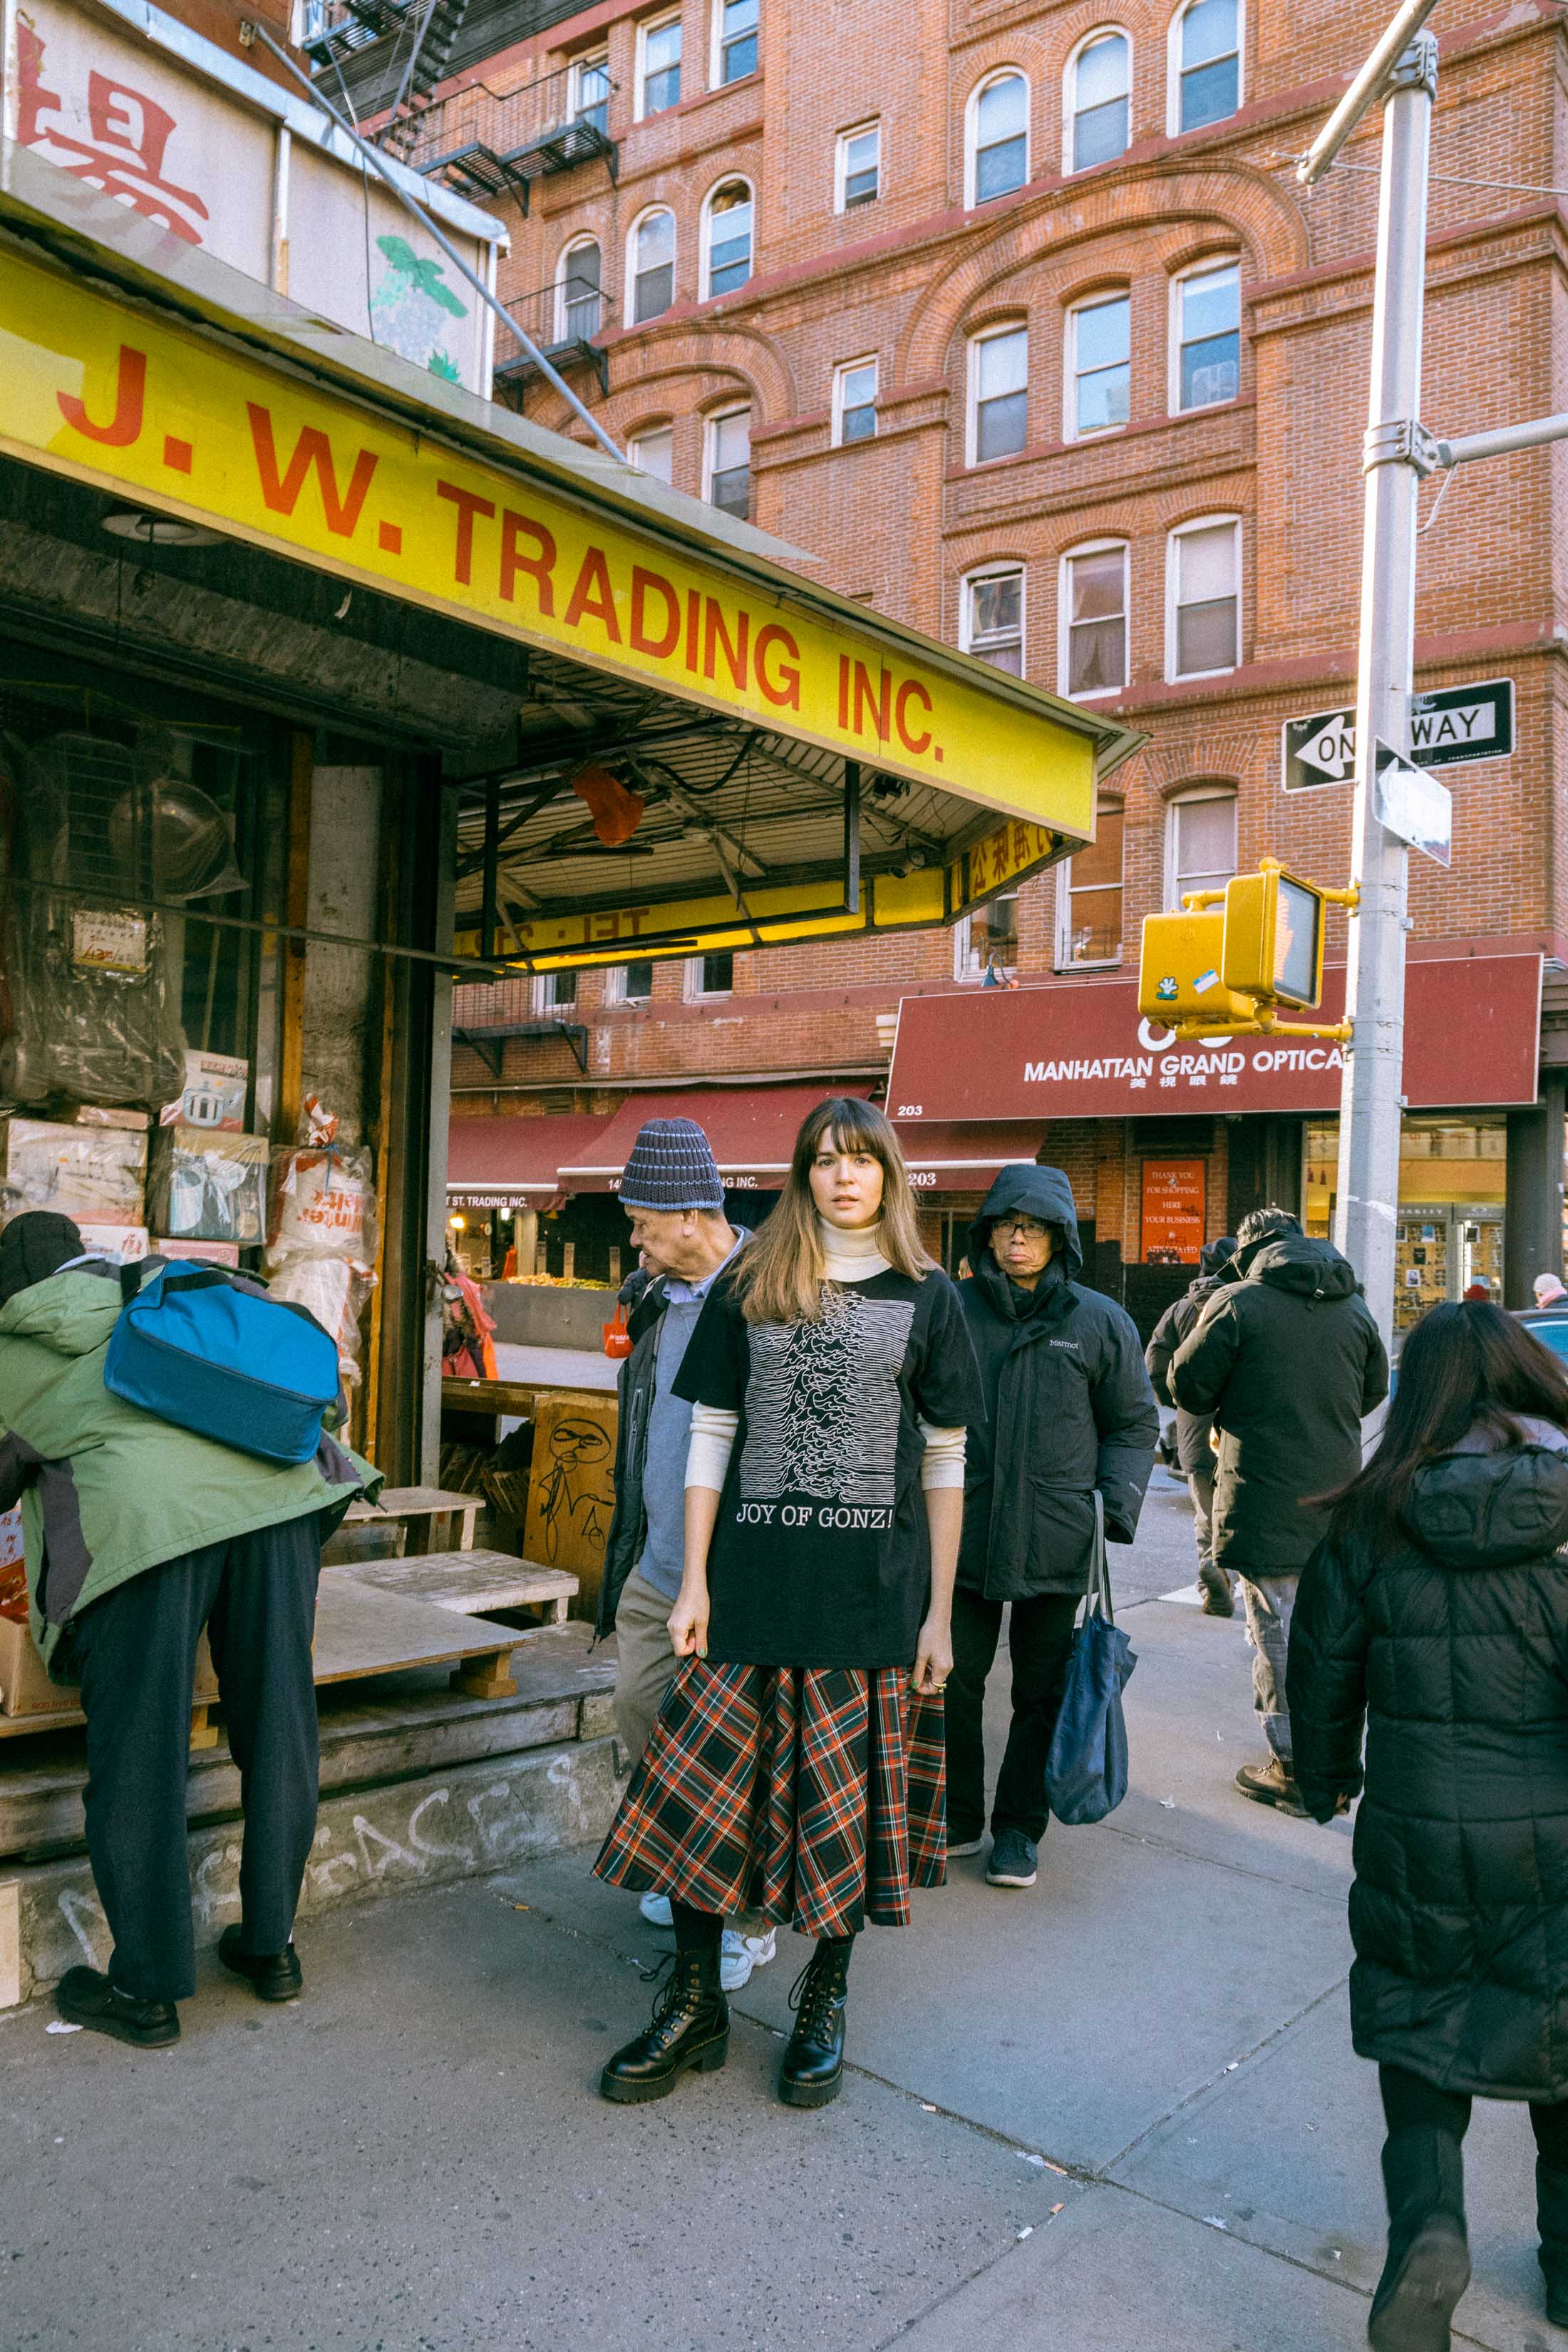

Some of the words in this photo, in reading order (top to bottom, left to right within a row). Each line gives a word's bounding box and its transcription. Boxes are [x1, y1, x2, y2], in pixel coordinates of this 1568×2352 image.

[56, 344, 192, 475] J.
[246, 401, 402, 555] W.
[437, 480, 800, 711] TRADING
[837, 654, 944, 763] INC.
[1319, 731, 1356, 763] ON
[1410, 709, 1480, 746] WAY
[1023, 1057, 1153, 1083] MANHATTAN
[1160, 1053, 1246, 1076] GRAND
[1252, 1048, 1344, 1071] OPTICA
[897, 1105, 923, 1117] 203
[608, 1178, 623, 1190] 14
[736, 1176, 758, 1188] INC.
[907, 1172, 937, 1187] 203
[1146, 1186, 1161, 1195] FOR
[452, 1196, 465, 1207] ST.
[467, 1196, 507, 1207] TRADING
[509, 1197, 528, 1207] INC.
[1162, 1201, 1182, 1209] HERE
[1049, 1339, 1079, 1350] Marmot
[736, 1503, 778, 1525] JOY
[781, 1505, 813, 1527] OF
[818, 1507, 893, 1530] GONZ!
